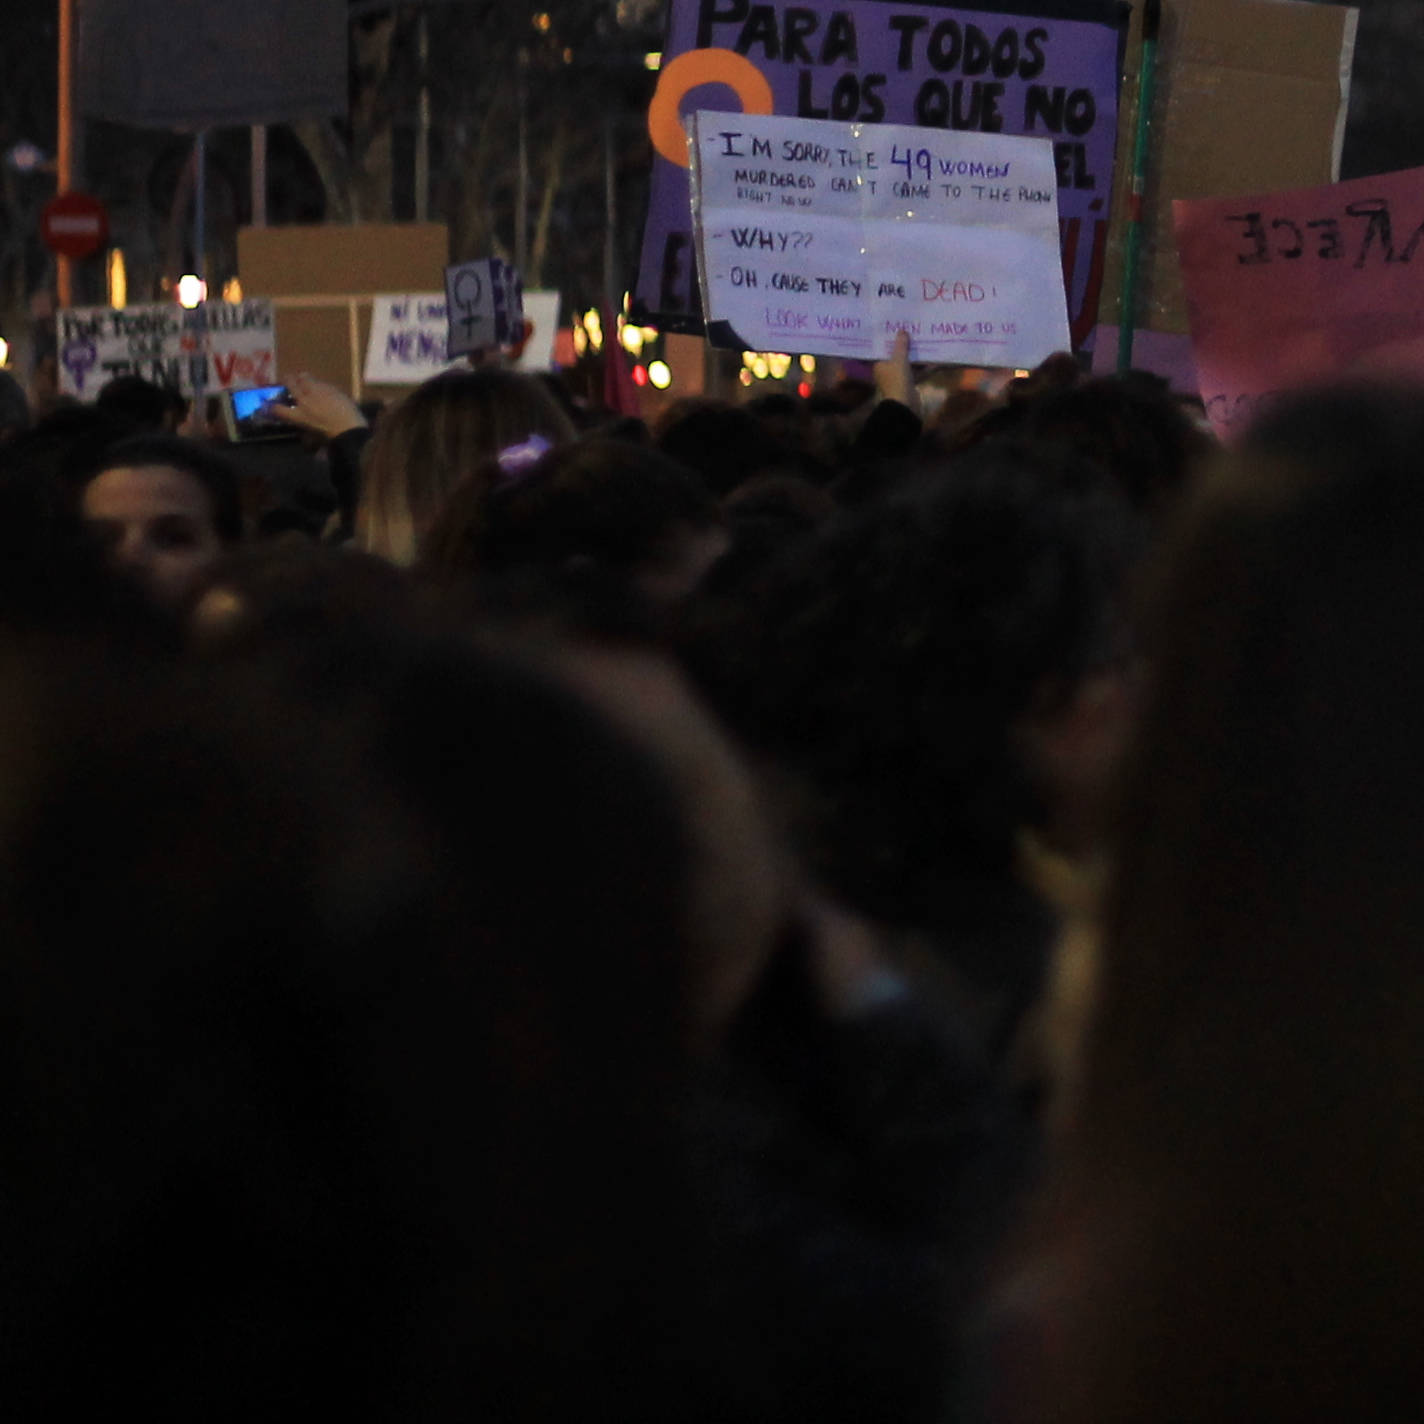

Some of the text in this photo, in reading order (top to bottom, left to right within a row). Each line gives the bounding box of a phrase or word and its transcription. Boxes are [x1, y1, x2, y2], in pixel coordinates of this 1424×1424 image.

[889, 15, 1047, 78] TODOS
[800, 70, 1096, 136] LOS QUE NO
[891, 144, 931, 180] 49
[938, 158, 1010, 178] WOMEN
[734, 170, 816, 189] MURDERED
[941, 184, 961, 198] TO
[971, 185, 1010, 202] THE
[731, 228, 814, 252] WHY??
[816, 277, 861, 298] THEY
[878, 283, 906, 298] ARE
[766, 308, 808, 329] LOOK
